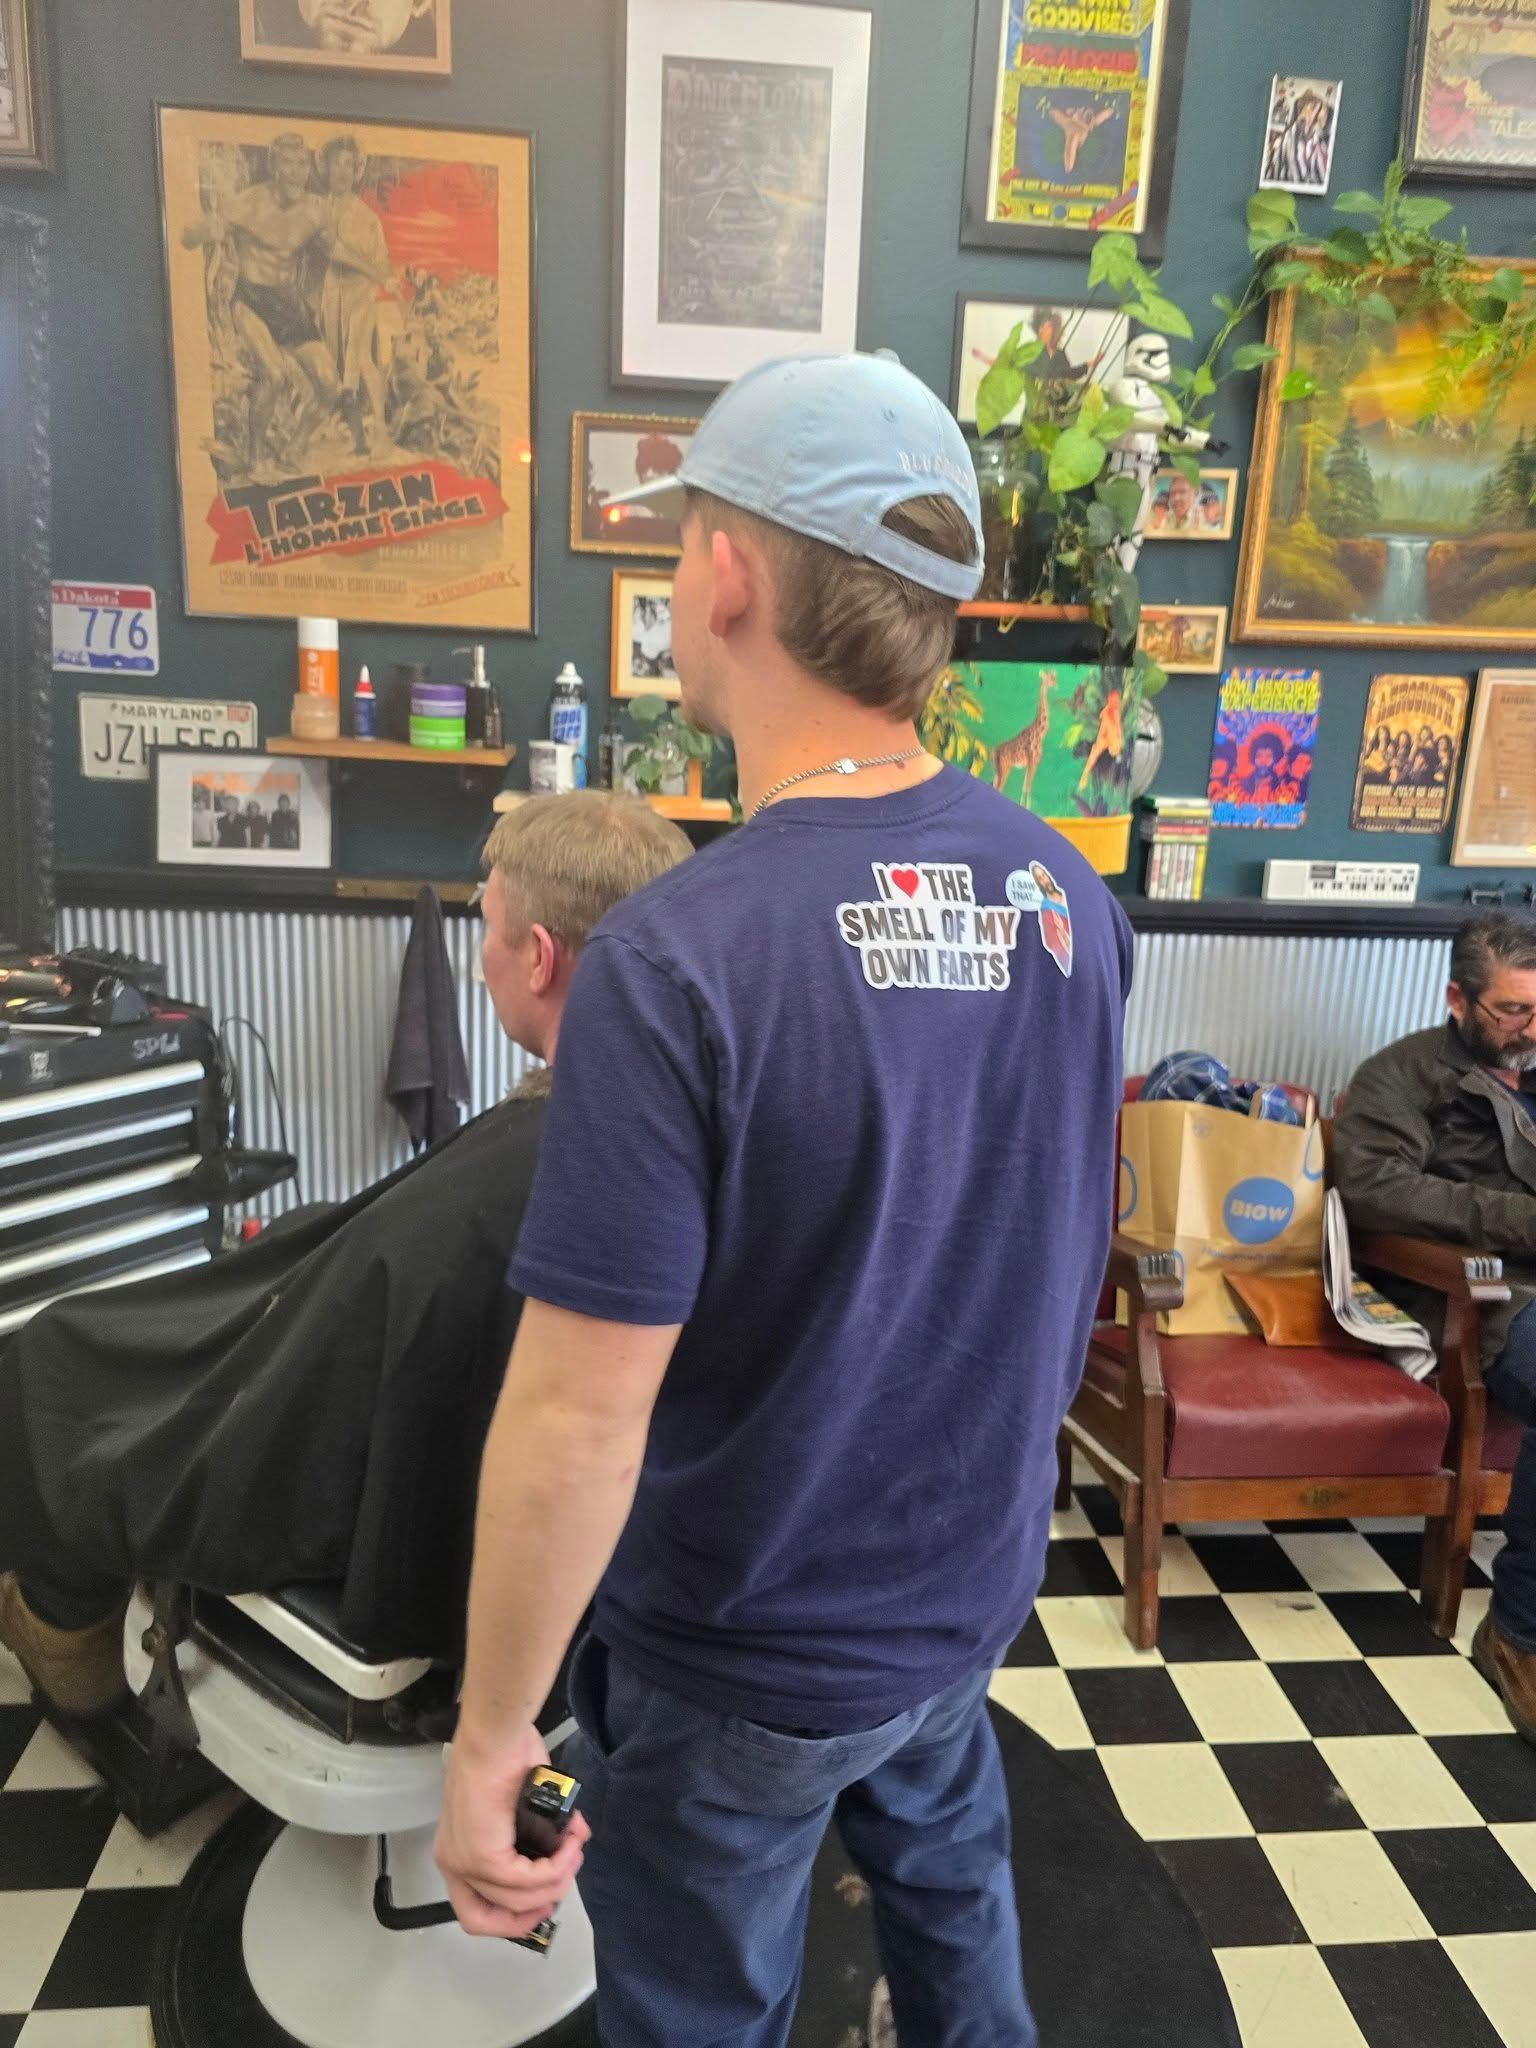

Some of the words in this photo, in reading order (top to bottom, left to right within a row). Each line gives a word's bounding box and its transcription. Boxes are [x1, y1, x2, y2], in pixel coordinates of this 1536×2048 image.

[223, 474, 435, 539] TARZAN
[244, 516, 384, 564] L'HOMME
[390, 495, 483, 533] SINGE
[61, 588, 119, 604] Dakota
[78, 607, 148, 650] 776
[121, 704, 212, 721] MARYLAND
[1221, 694, 1319, 714] EXPERIENCE
[94, 723, 158, 765] JZH
[877, 869, 892, 899] I
[922, 869, 972, 902] THE
[1017, 880, 1036, 891] SAW
[842, 907, 935, 942] SMELL
[941, 909, 966, 945] OF
[975, 911, 1015, 945] MY
[867, 948, 932, 985] OWN
[937, 950, 1006, 986] FARTS
